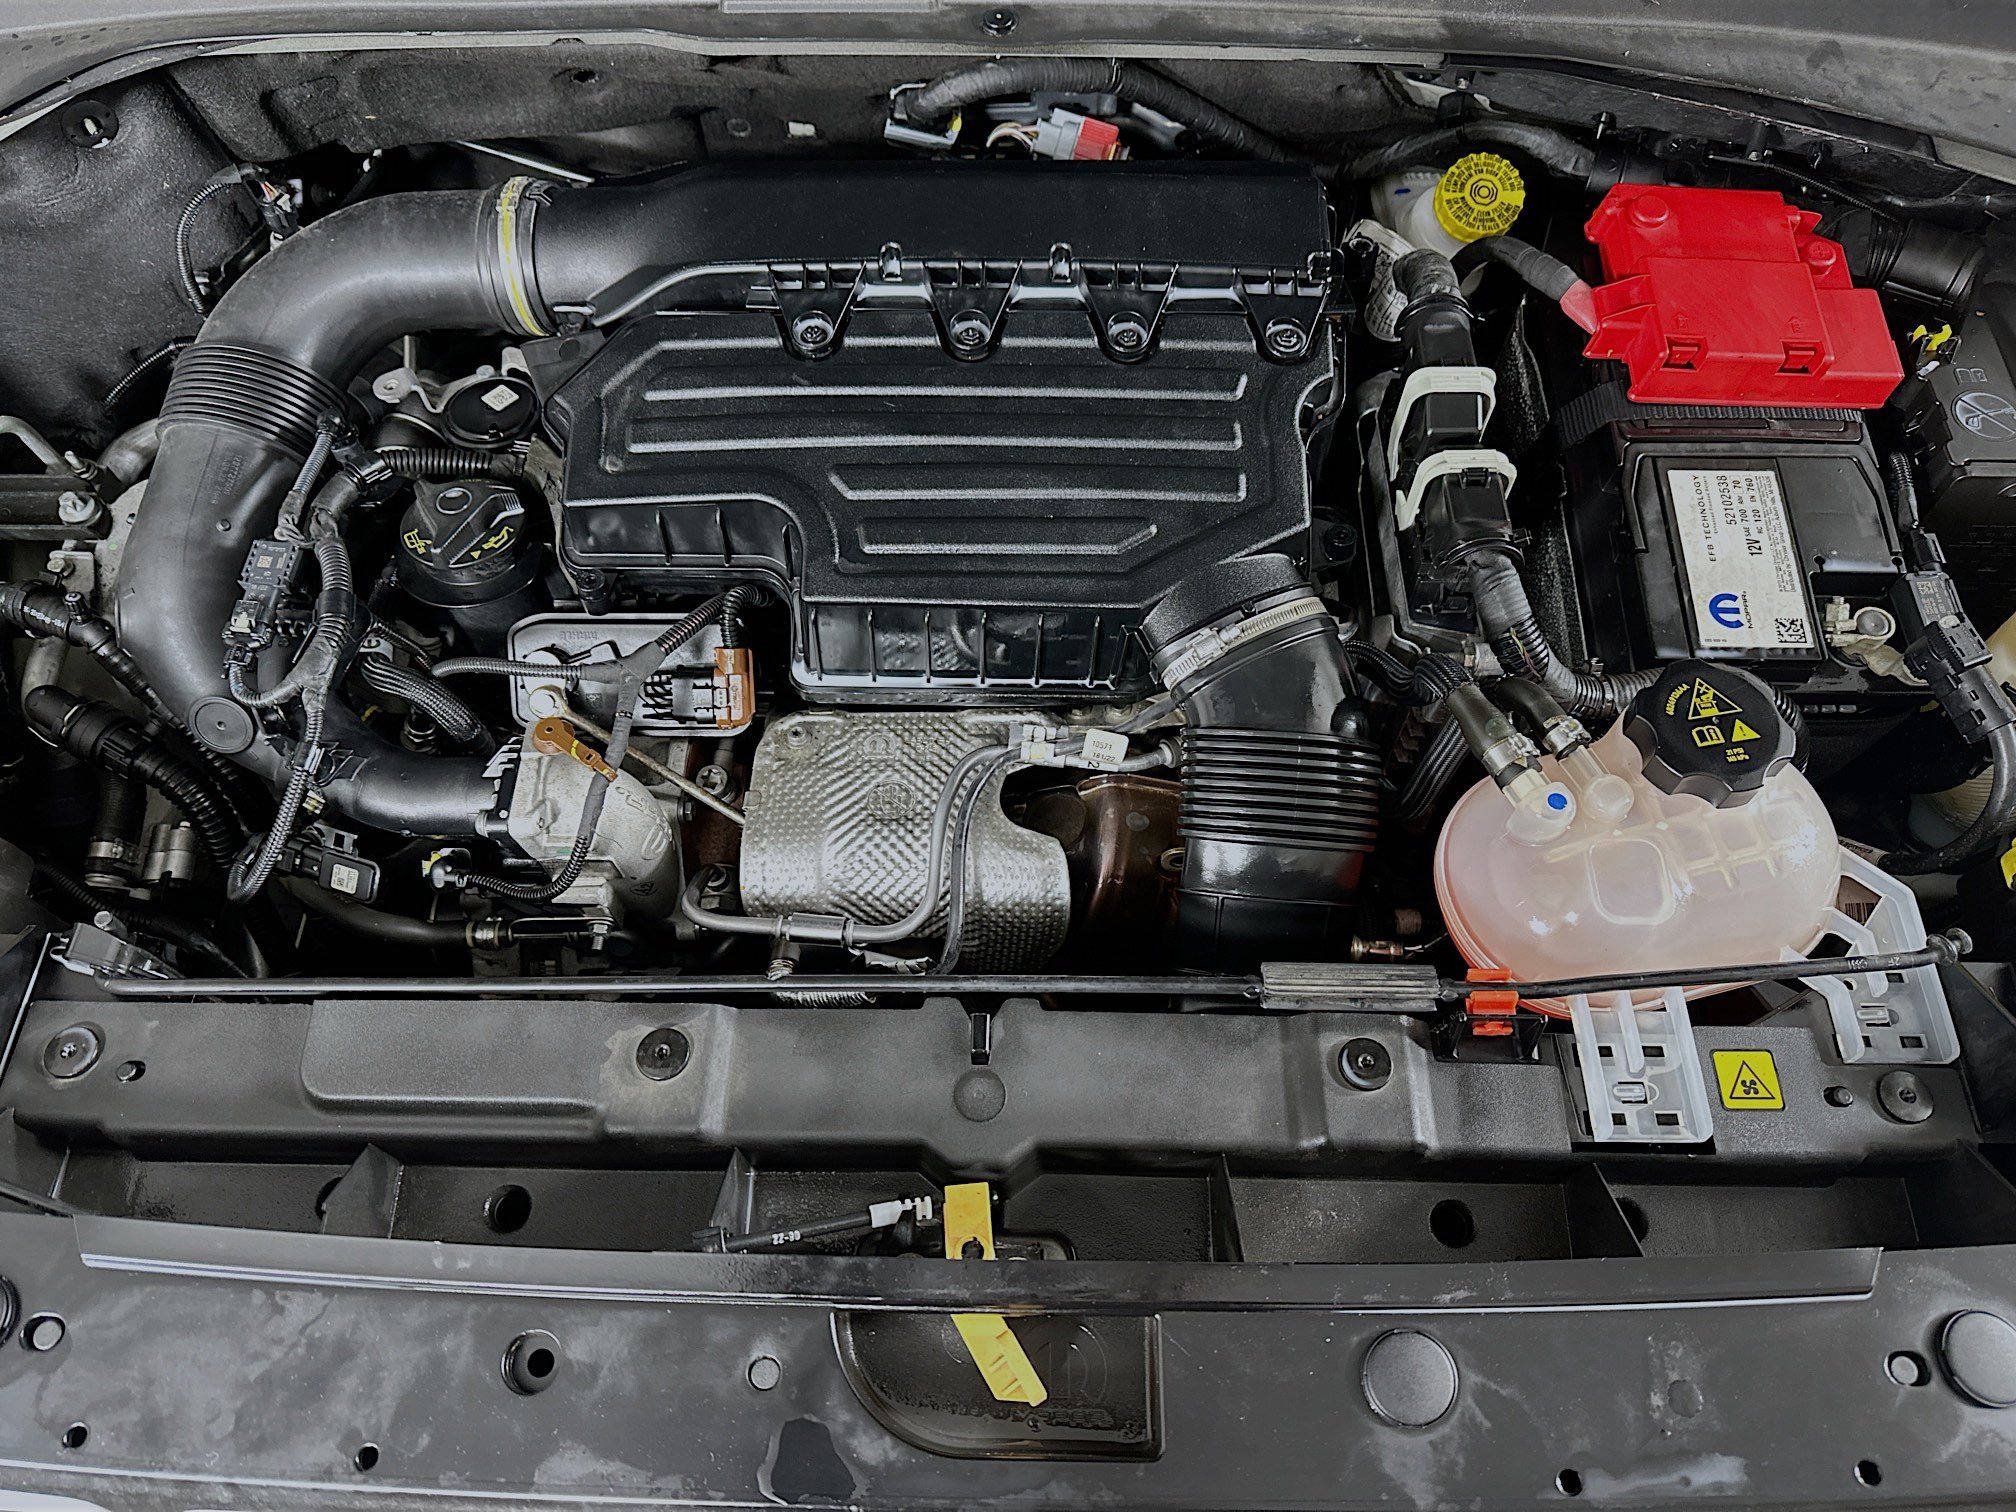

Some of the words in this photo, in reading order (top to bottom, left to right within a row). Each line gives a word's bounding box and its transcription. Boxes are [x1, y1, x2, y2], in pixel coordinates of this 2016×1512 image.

[1732, 480, 1742, 489] 70
[1745, 478, 1755, 491] 760
[1716, 475, 1737, 525] 52102538
[1692, 475, 1712, 540] TECHNOLOGY
[1739, 509, 1749, 523] 700
[1752, 509, 1762, 522] 120
[1743, 526, 1751, 537] SAE
[1707, 544, 1717, 562] EFB
[1746, 538, 1763, 556] 12V
[1092, 741, 1112, 750] 10571
